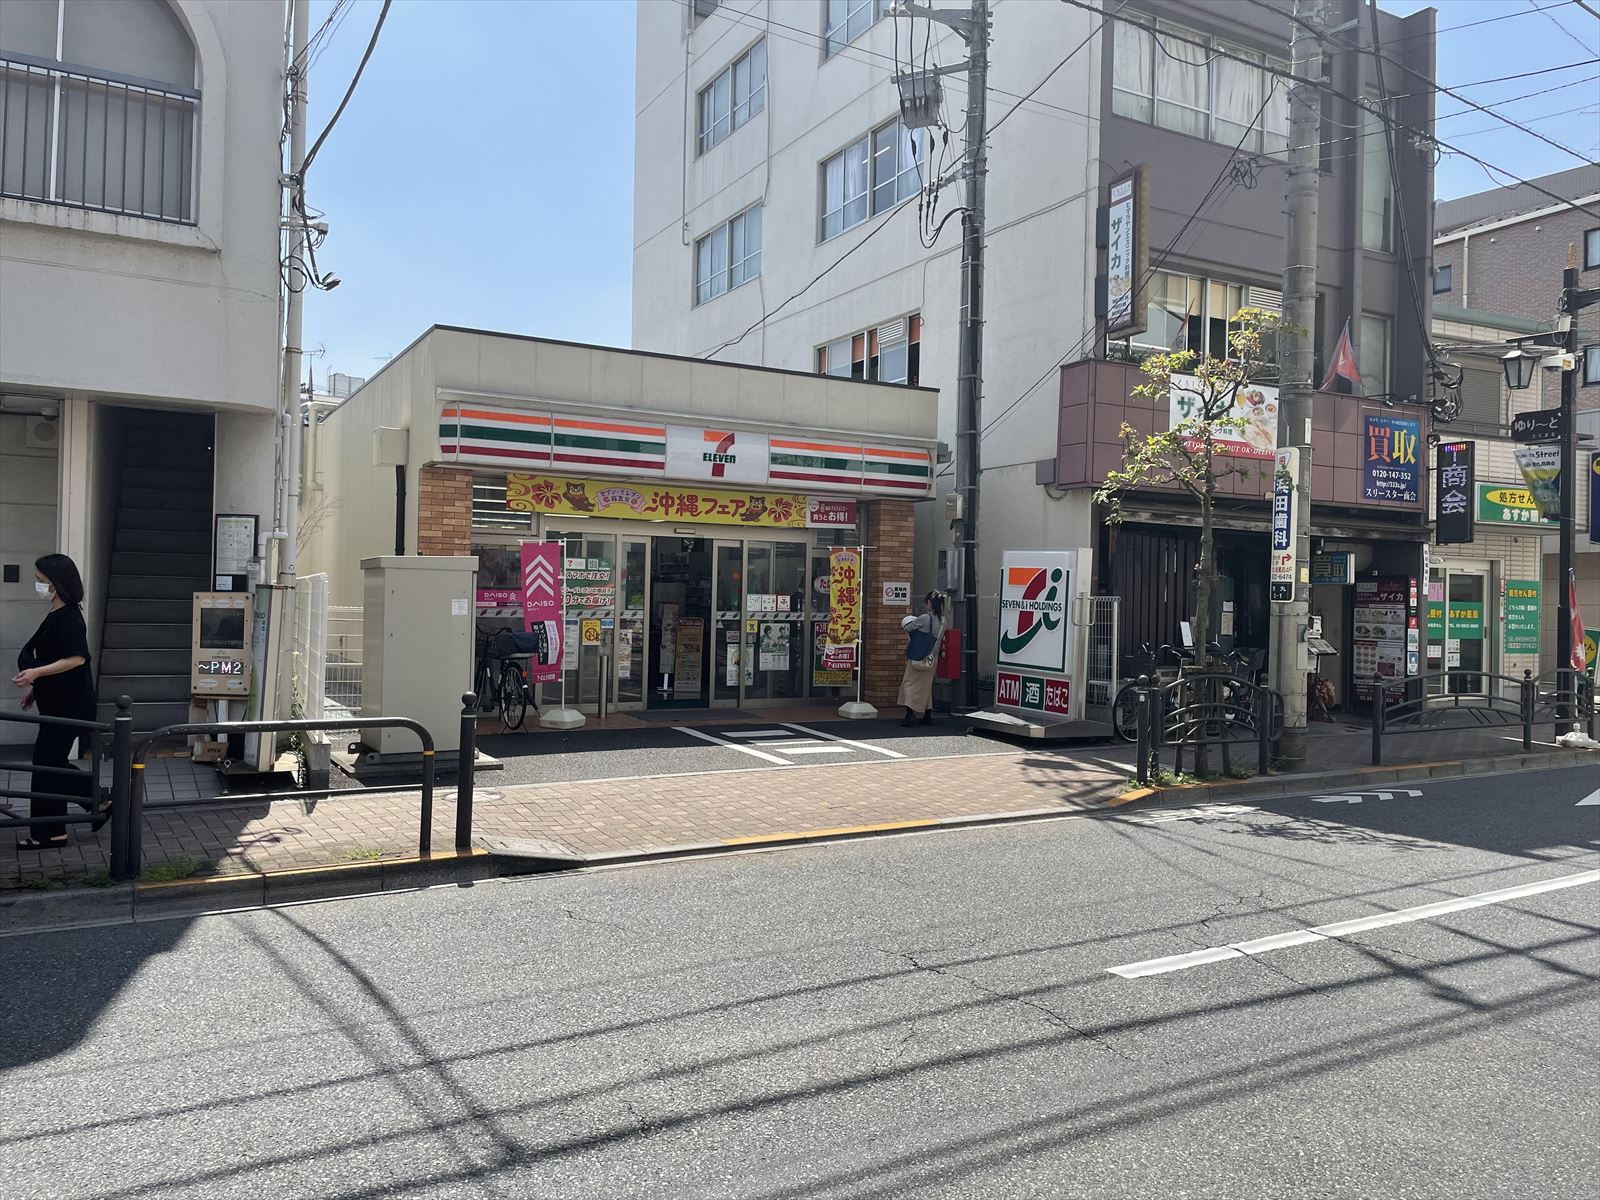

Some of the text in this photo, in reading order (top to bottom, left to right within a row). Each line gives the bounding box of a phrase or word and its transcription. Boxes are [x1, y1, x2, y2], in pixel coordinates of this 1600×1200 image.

[1111, 217, 1122, 270] ザイカ
[1368, 425, 1416, 465] 買取
[1535, 450, 1560, 459] Street
[1372, 469, 1411, 480] 0120-147-352
[643, 492, 746, 518] 沖縄フェア
[1366, 488, 1417, 501] スリースター商会
[832, 566, 857, 637] 沖縄フェア
[1029, 601, 1062, 612] HOLDINGS
[999, 678, 1020, 701] ATM
[1025, 682, 1041, 704] 酒
[1045, 685, 1069, 709] たばこ
